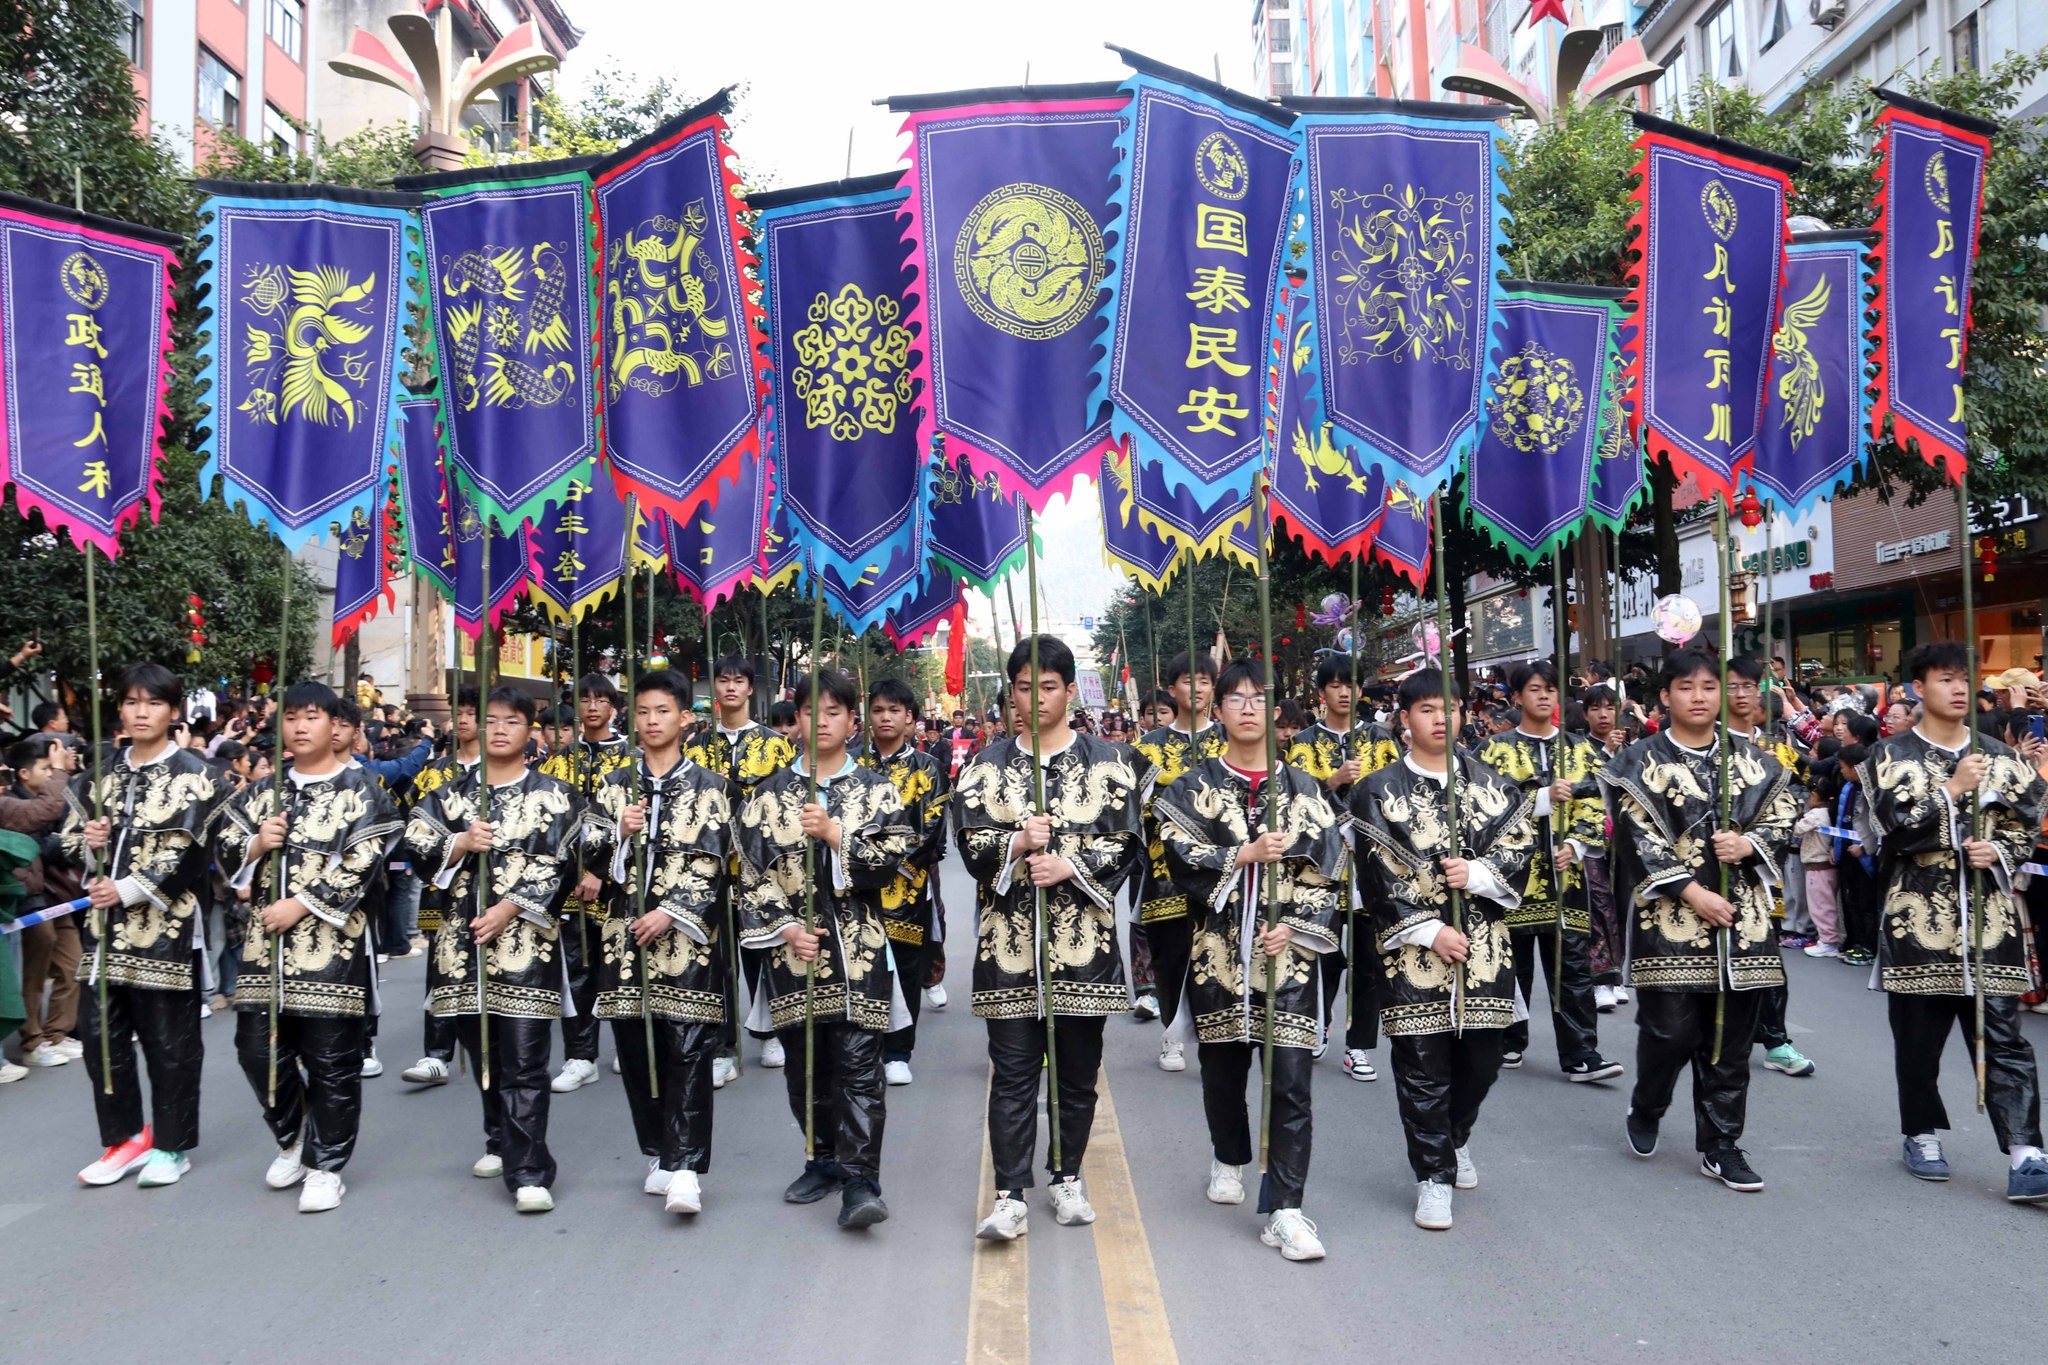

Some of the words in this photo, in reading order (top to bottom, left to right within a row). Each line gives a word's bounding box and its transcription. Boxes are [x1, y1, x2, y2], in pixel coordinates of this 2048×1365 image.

[64, 313, 111, 499] 政通人和
[1178, 202, 1252, 437] 国泰民安
